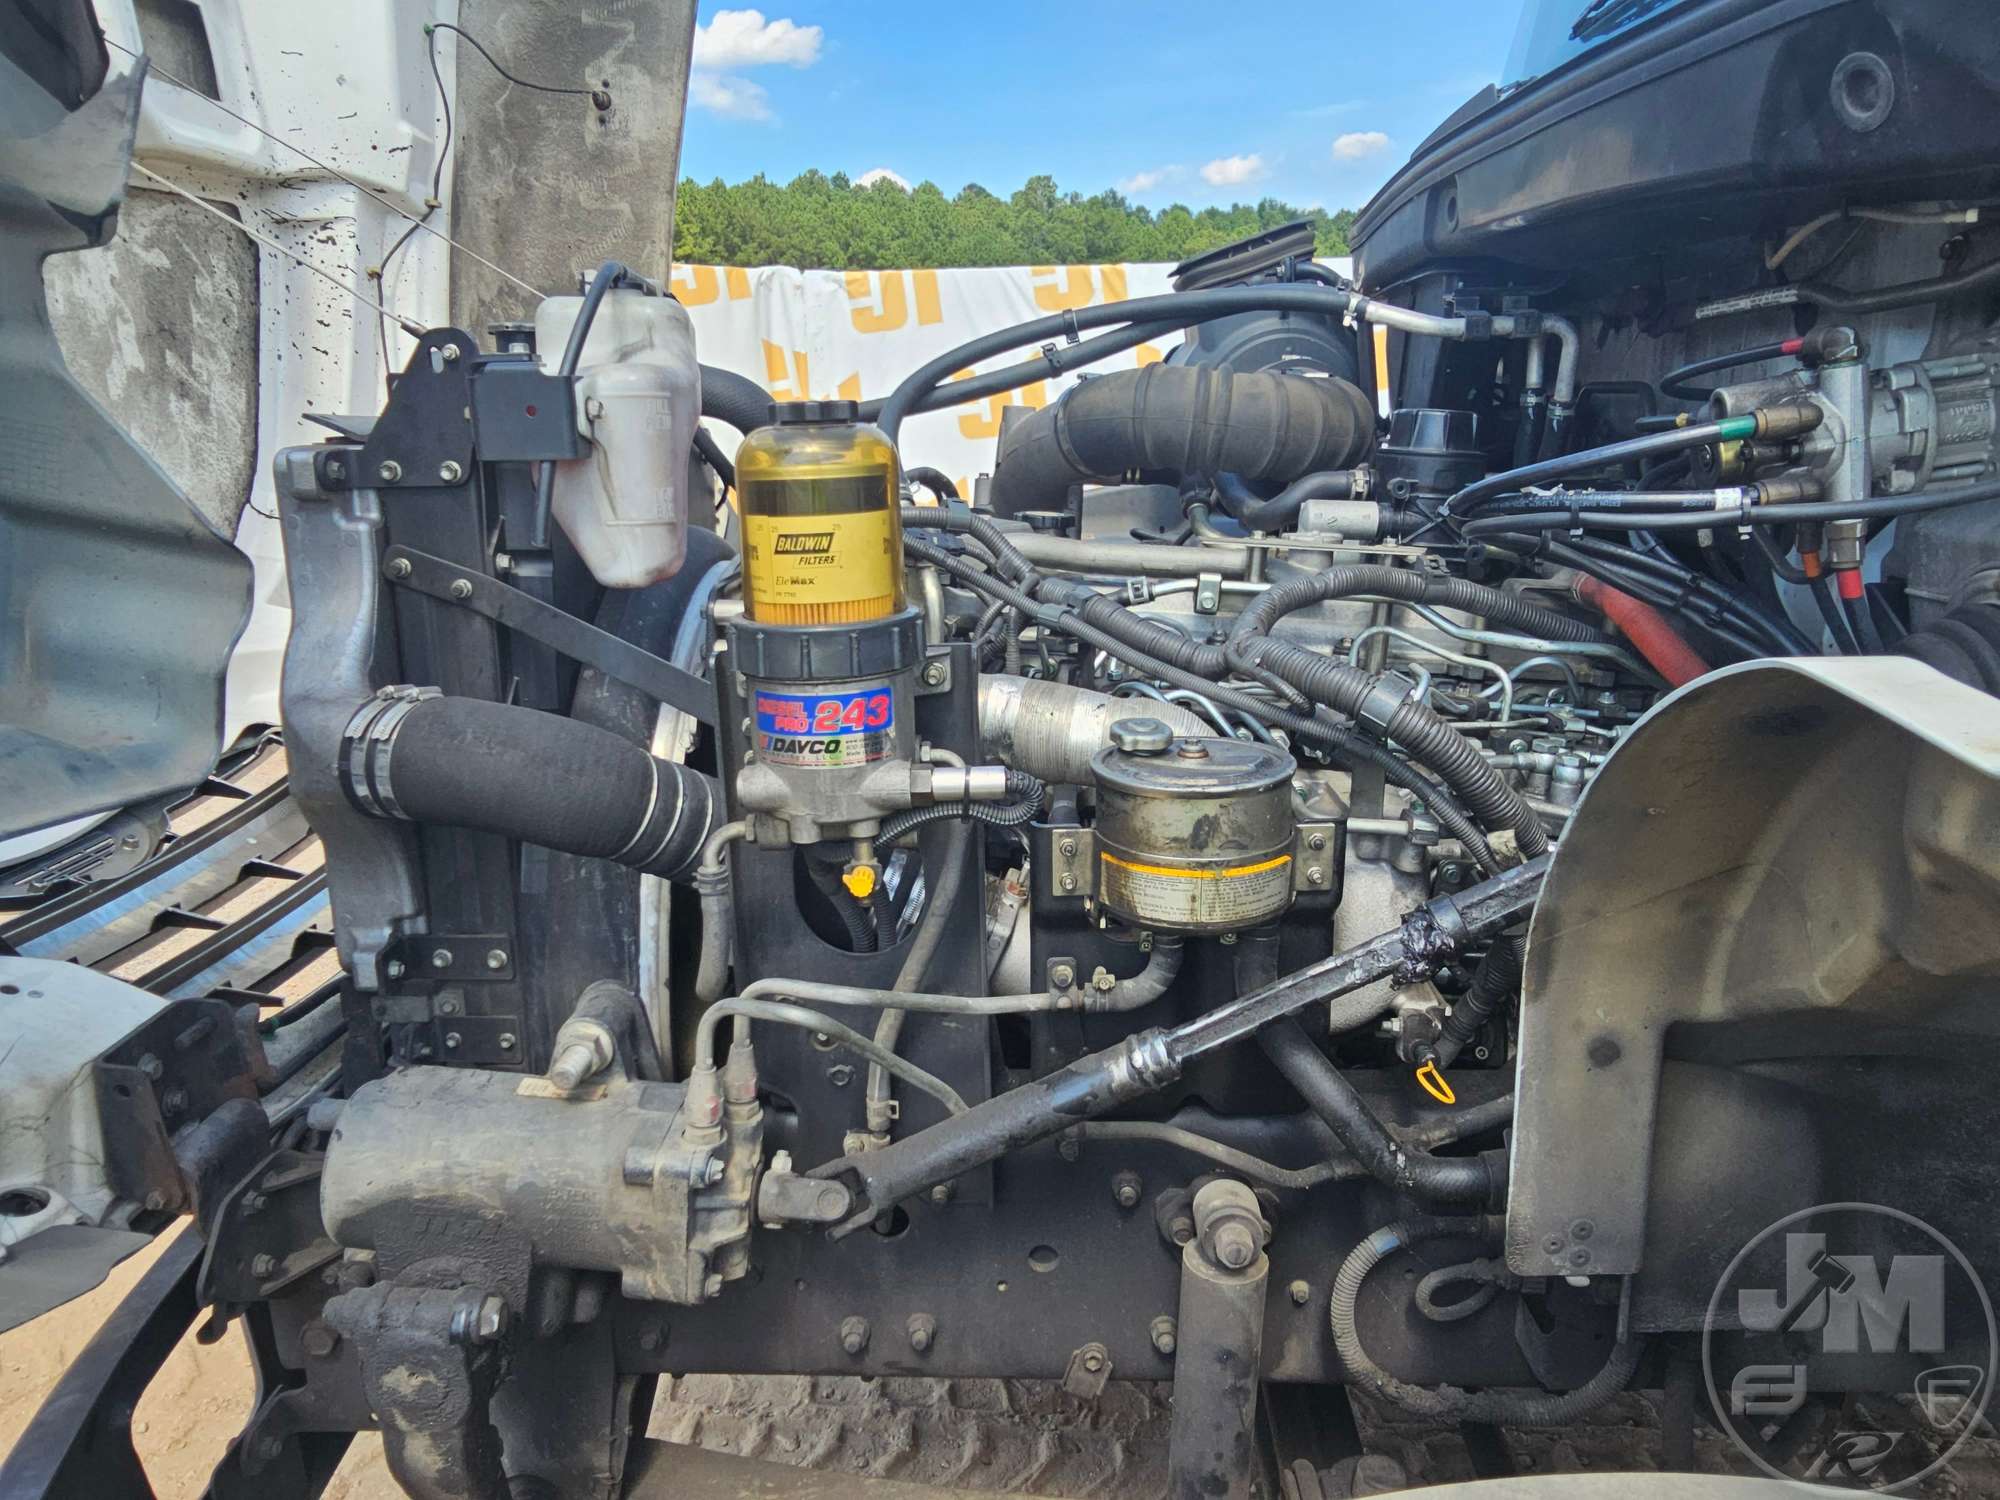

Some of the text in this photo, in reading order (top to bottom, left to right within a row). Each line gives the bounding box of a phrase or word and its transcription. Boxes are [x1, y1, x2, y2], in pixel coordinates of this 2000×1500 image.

[776, 535, 831, 552] BALDWIN
[798, 555, 836, 566] FILTERS
[813, 695, 890, 734] 243
[772, 738, 841, 755] DAVCO
